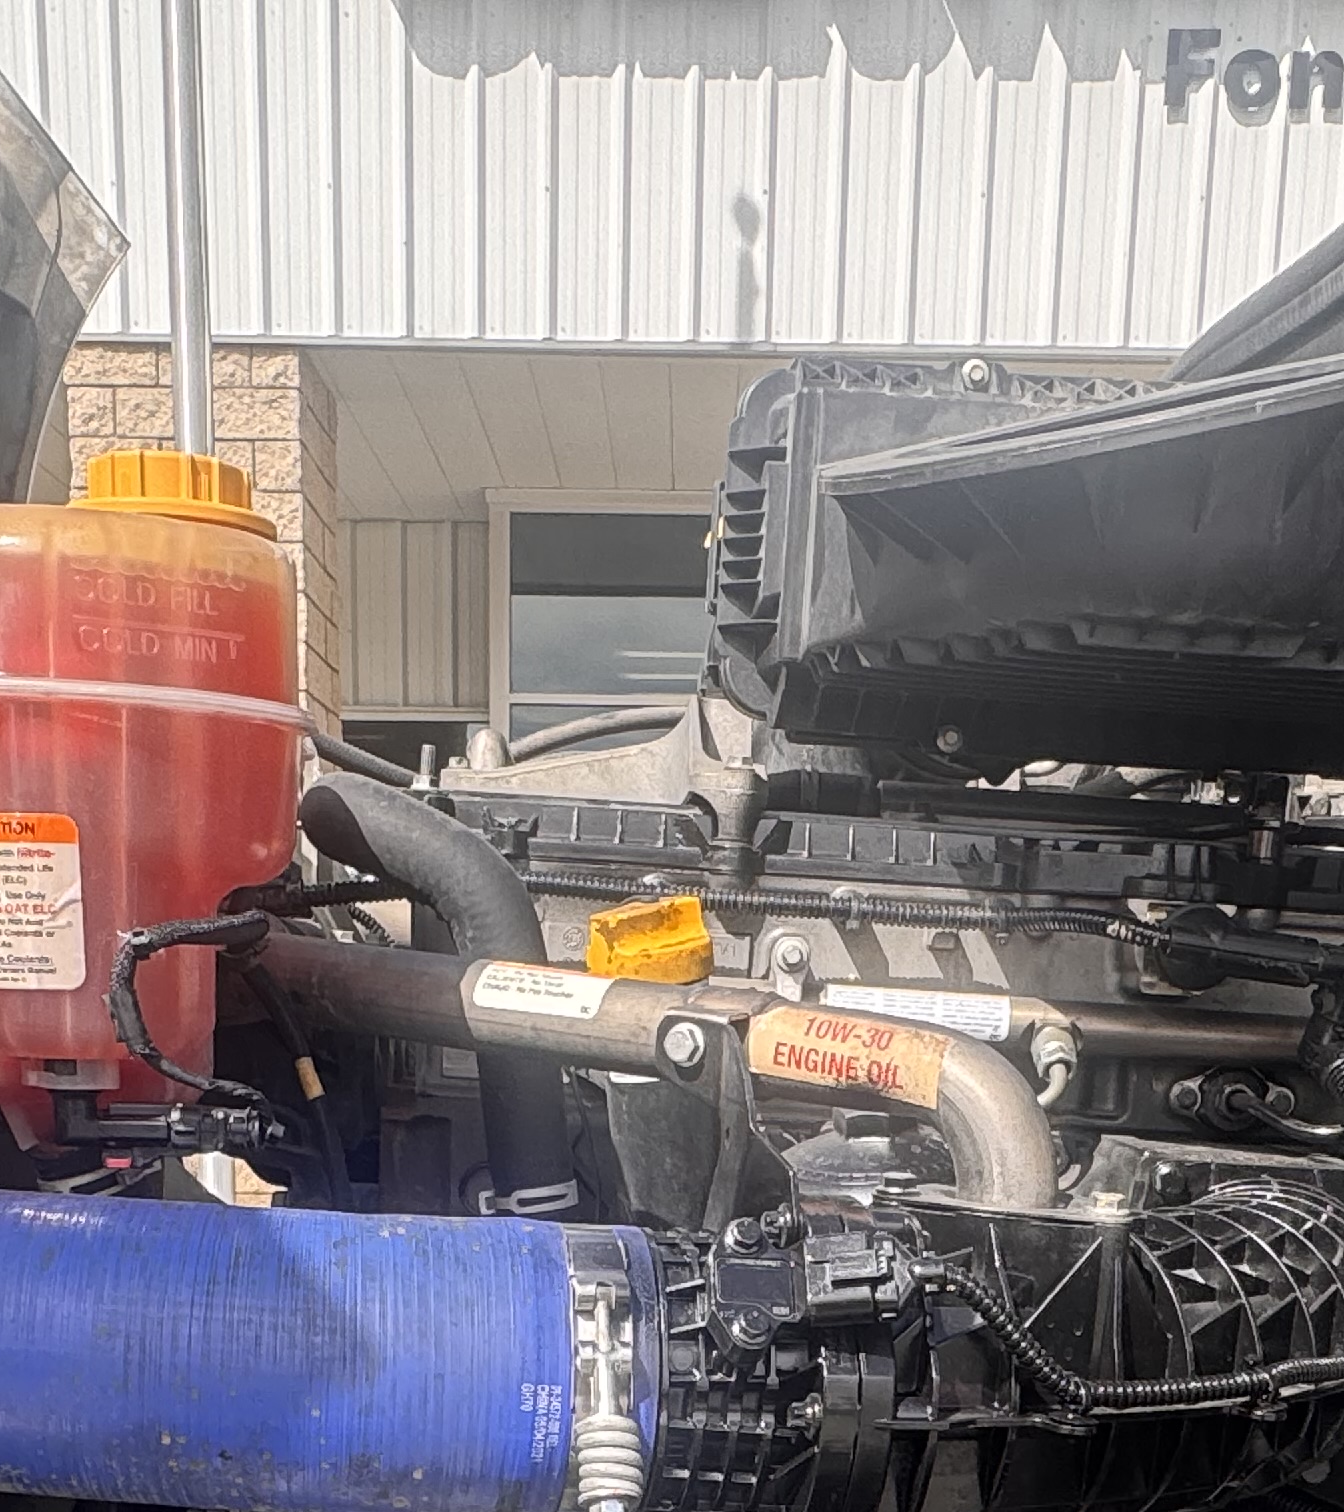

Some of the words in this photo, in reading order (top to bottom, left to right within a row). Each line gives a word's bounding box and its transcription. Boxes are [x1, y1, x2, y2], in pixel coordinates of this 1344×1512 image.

[74, 574, 156, 607] COLD
[171, 586, 219, 616] FILL
[79, 625, 160, 656] COLD
[174, 635, 217, 663] MIN
[5, 891, 23, 899] Use
[25, 892, 46, 901] Only
[5, 904, 28, 913] OAT
[33, 904, 55, 914] ELC
[804, 1016, 894, 1051] 10W-30
[773, 1041, 860, 1082] ENGINE
[866, 1056, 904, 1090] OIL
